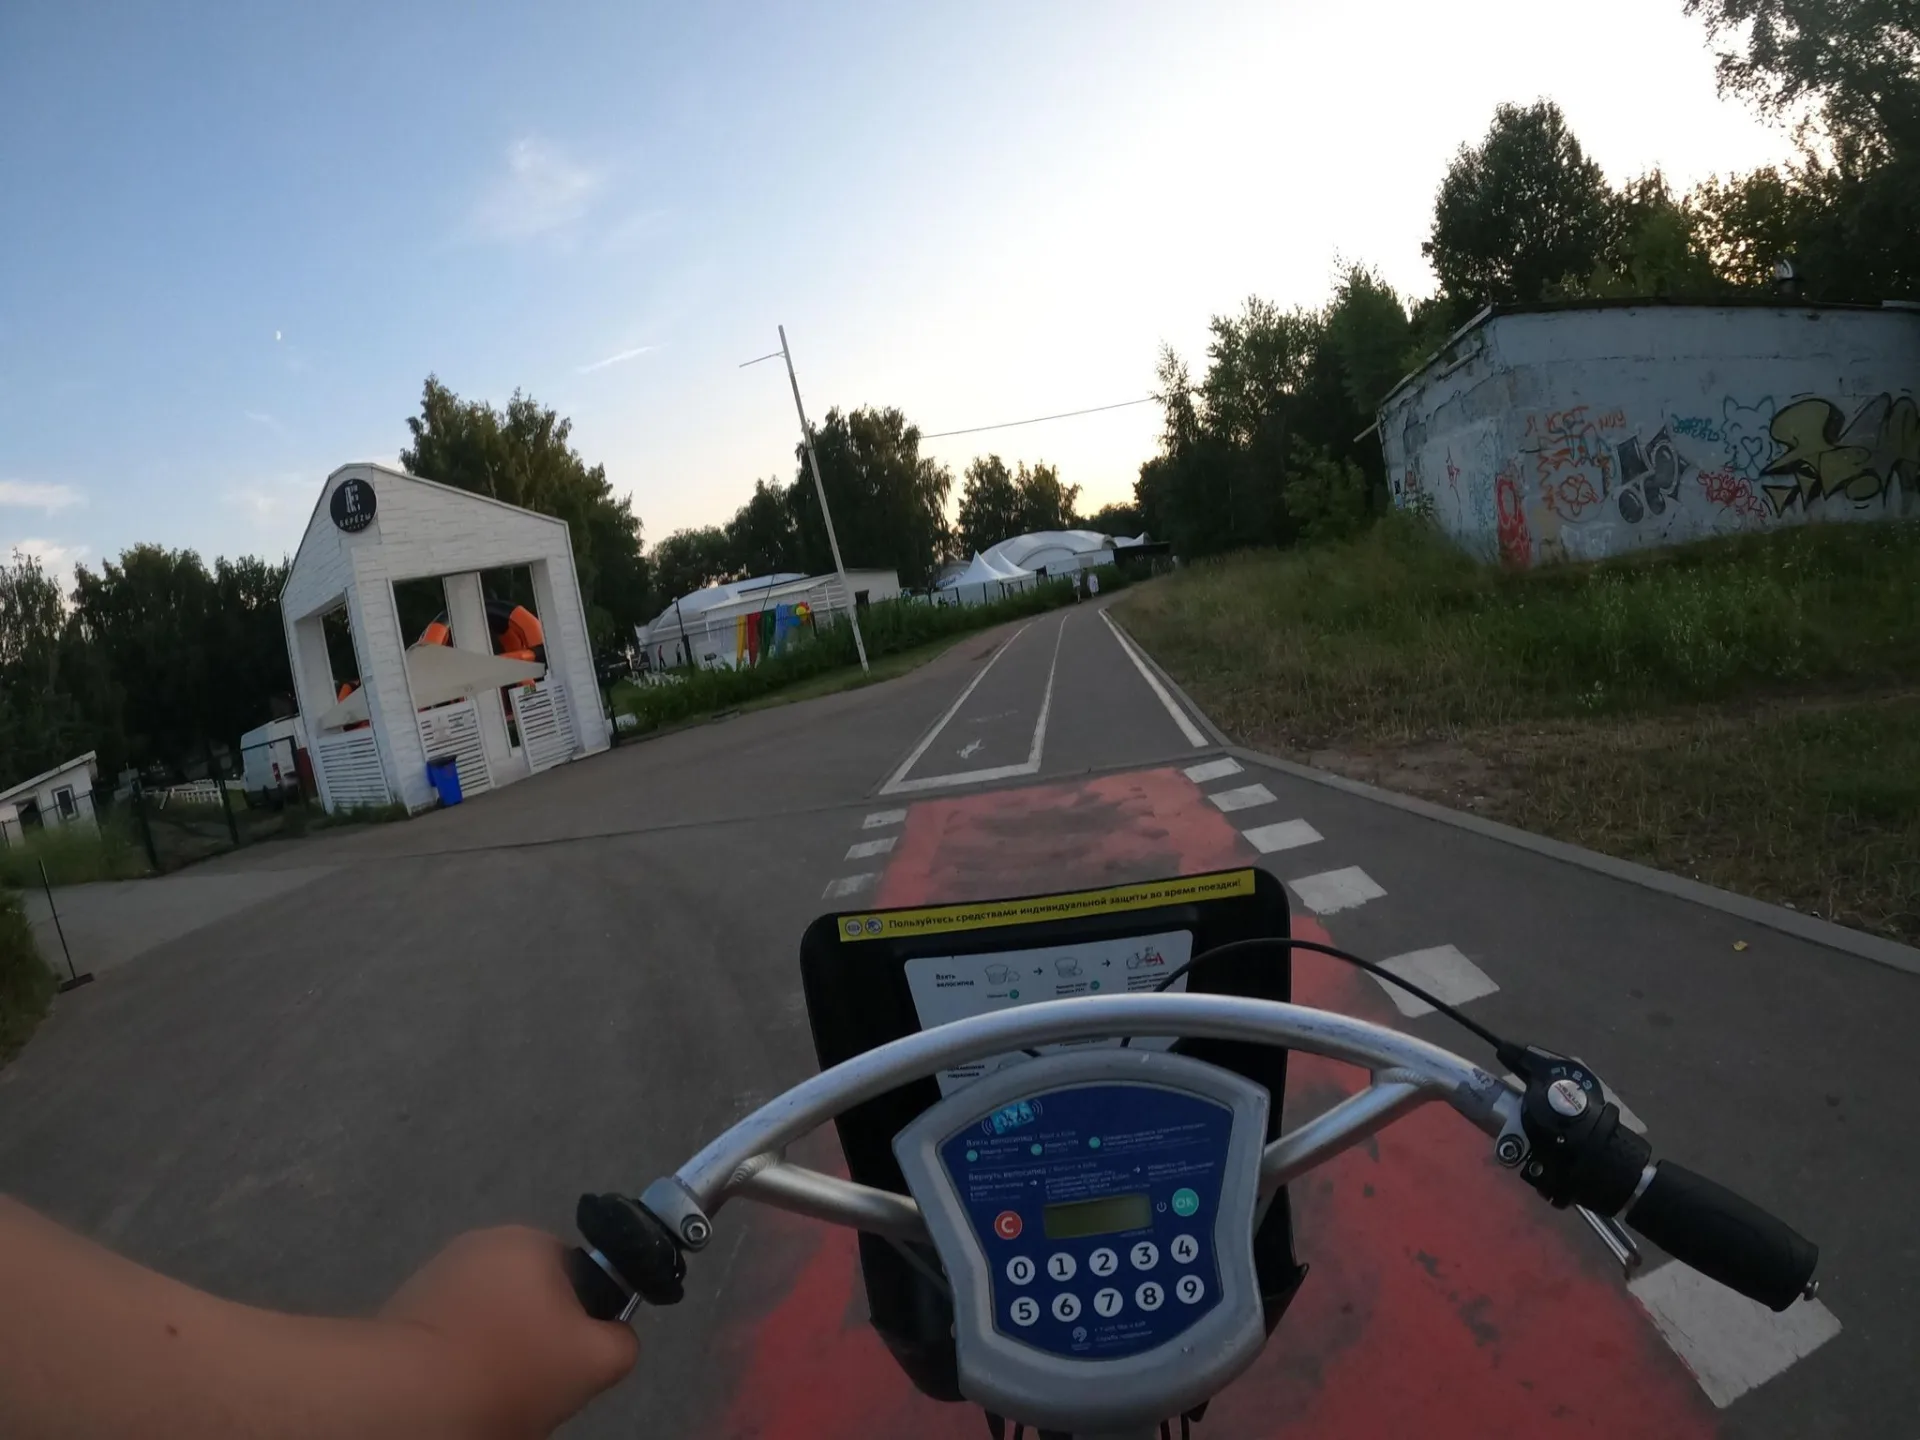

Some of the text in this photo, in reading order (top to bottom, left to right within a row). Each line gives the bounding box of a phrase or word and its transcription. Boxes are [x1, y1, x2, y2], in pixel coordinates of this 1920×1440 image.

[888, 916, 954, 929] Пользуйтесь
[956, 908, 1017, 923] средствами
[1020, 897, 1107, 914] индивидуальной
[1110, 893, 1148, 905] защиты
[1150, 891, 1162, 899] во
[1198, 877, 1241, 893] поездки!
[1558, 1082, 1583, 1111] NEXUS
[1175, 1196, 1194, 1209] OK
[1001, 1217, 1014, 1234] C
[1013, 1239, 1191, 1279] 0 1 2 3 4
[1018, 1280, 1197, 1320] 5 6 7 8 9
